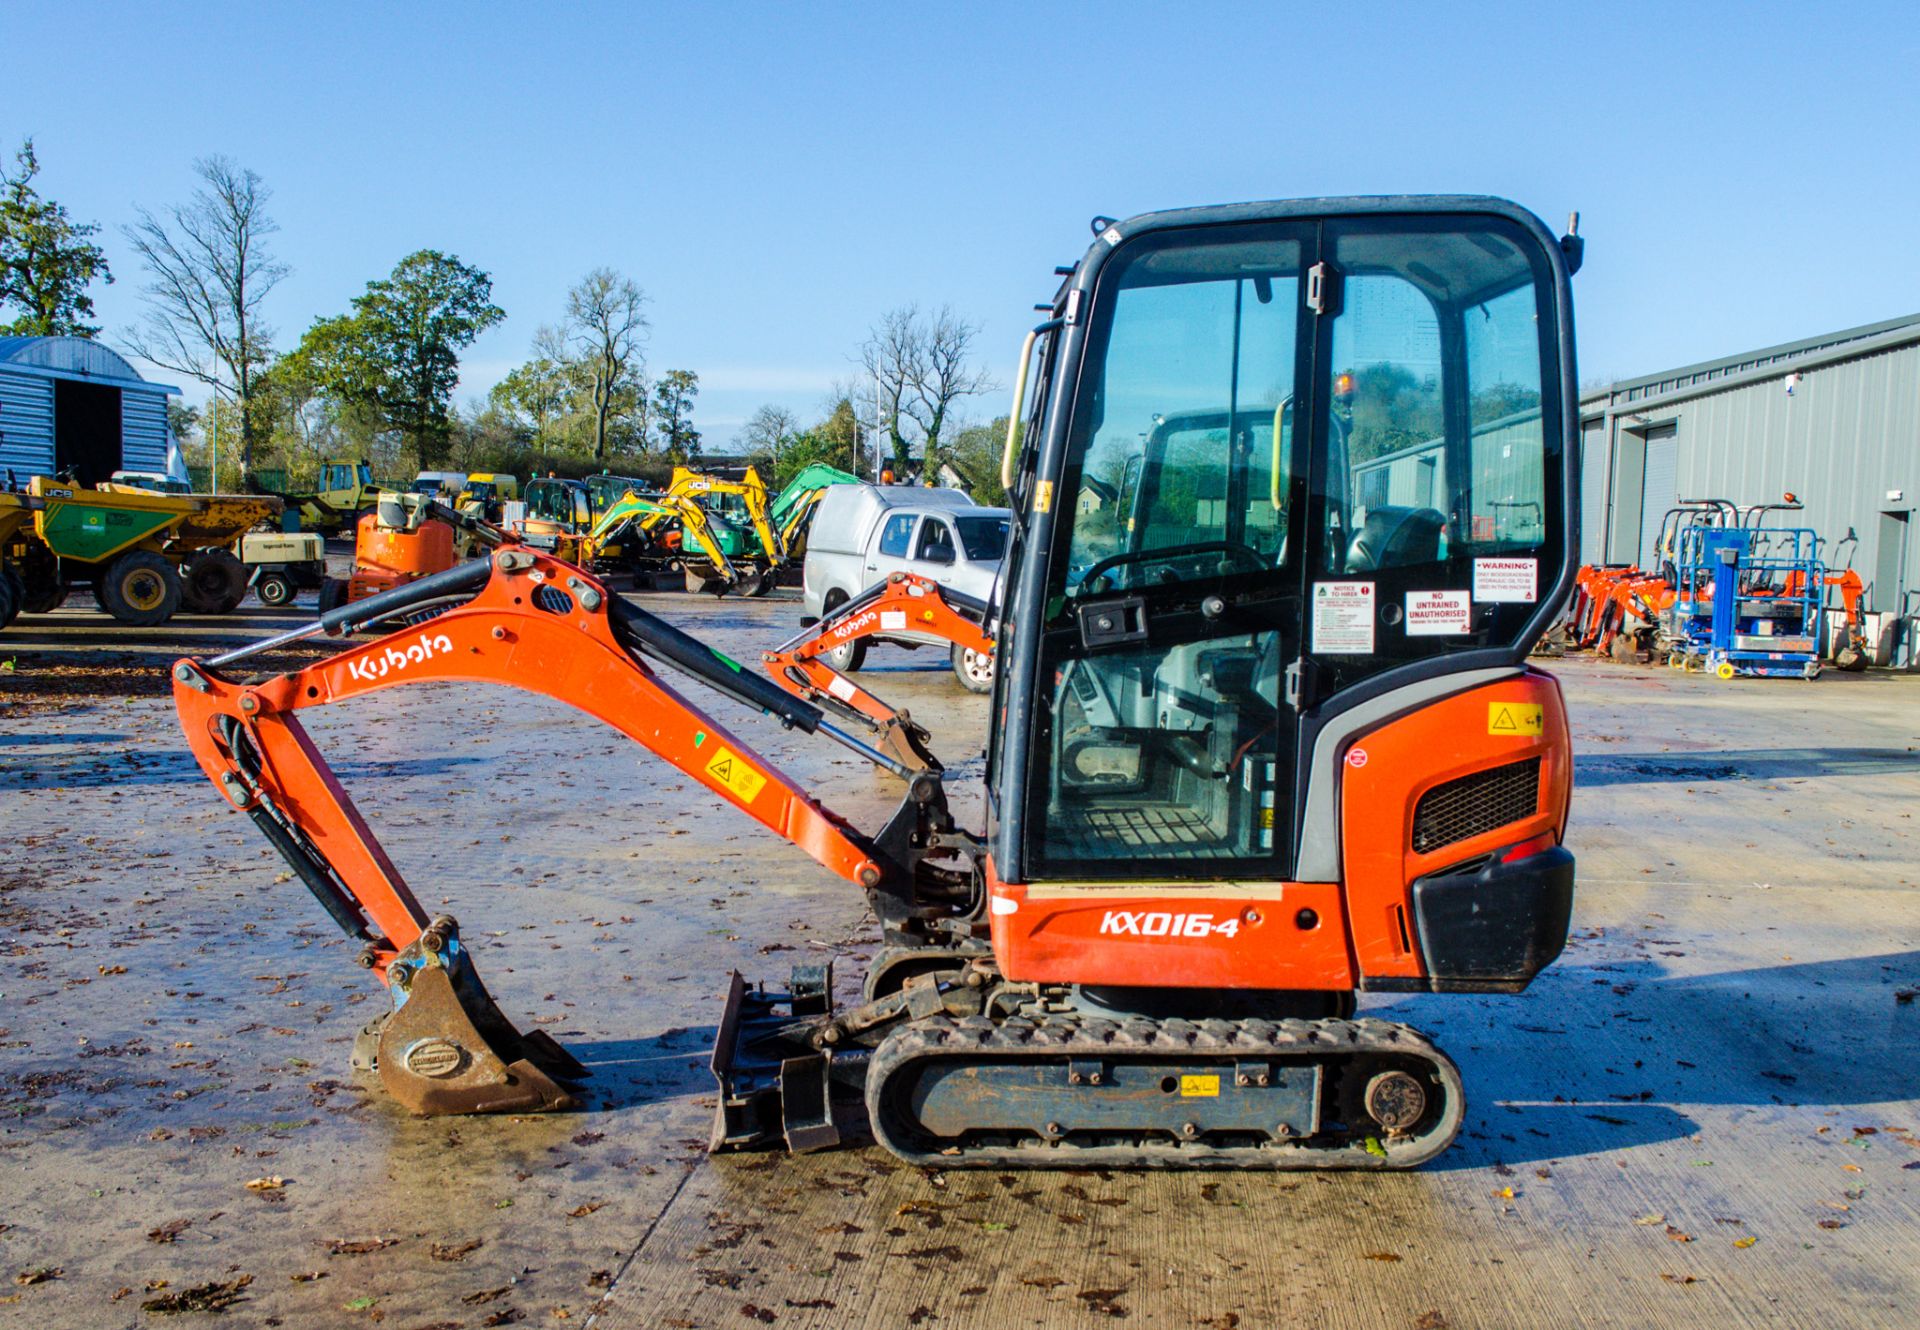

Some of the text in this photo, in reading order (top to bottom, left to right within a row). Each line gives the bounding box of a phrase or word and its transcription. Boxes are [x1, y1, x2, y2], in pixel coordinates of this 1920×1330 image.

[45, 489, 73, 498] JCB
[1432, 592, 1444, 600] NO
[1416, 601, 1460, 609] UNTRAINED
[1409, 610, 1467, 618] UNAUTHORISED
[833, 612, 877, 638] Kubota
[348, 634, 453, 680] Kubota
[1099, 911, 1239, 938] KX016-4
